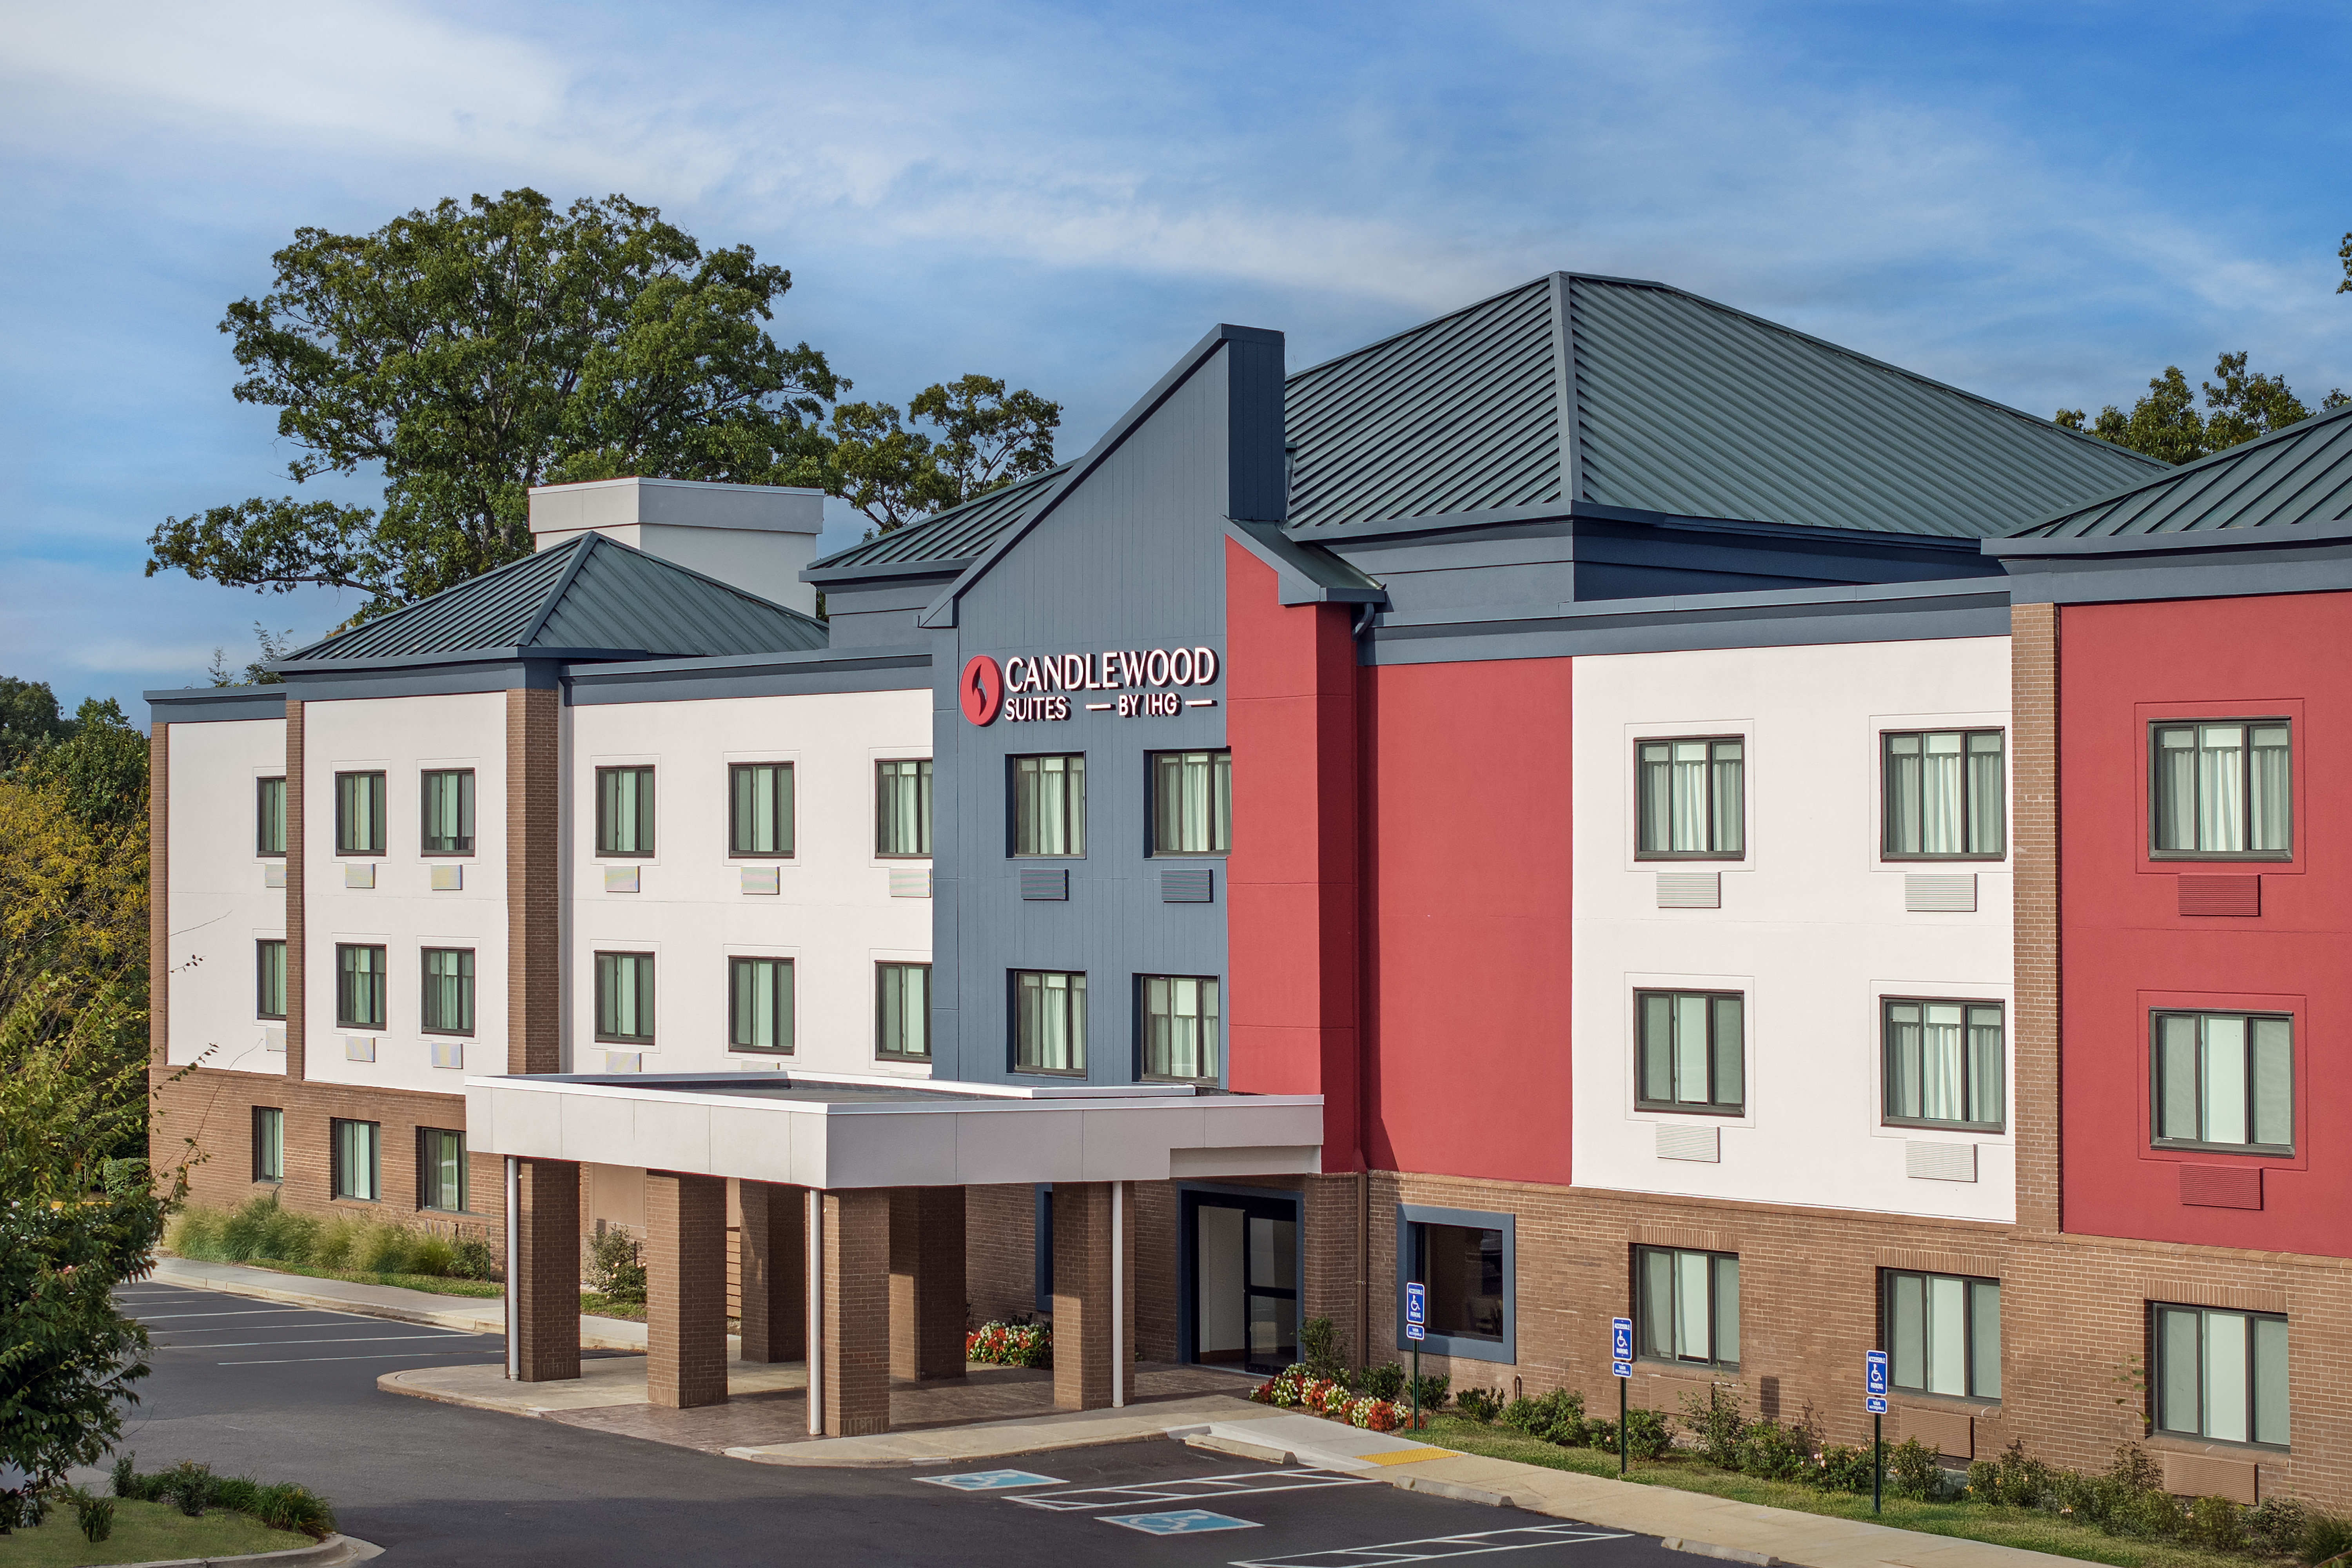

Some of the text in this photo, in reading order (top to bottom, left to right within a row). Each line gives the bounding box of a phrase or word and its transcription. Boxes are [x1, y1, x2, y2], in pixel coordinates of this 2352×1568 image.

[1005, 647, 1215, 692] CANDLEWOOD
[1004, 692, 1177, 720] SUITES BY IHG
